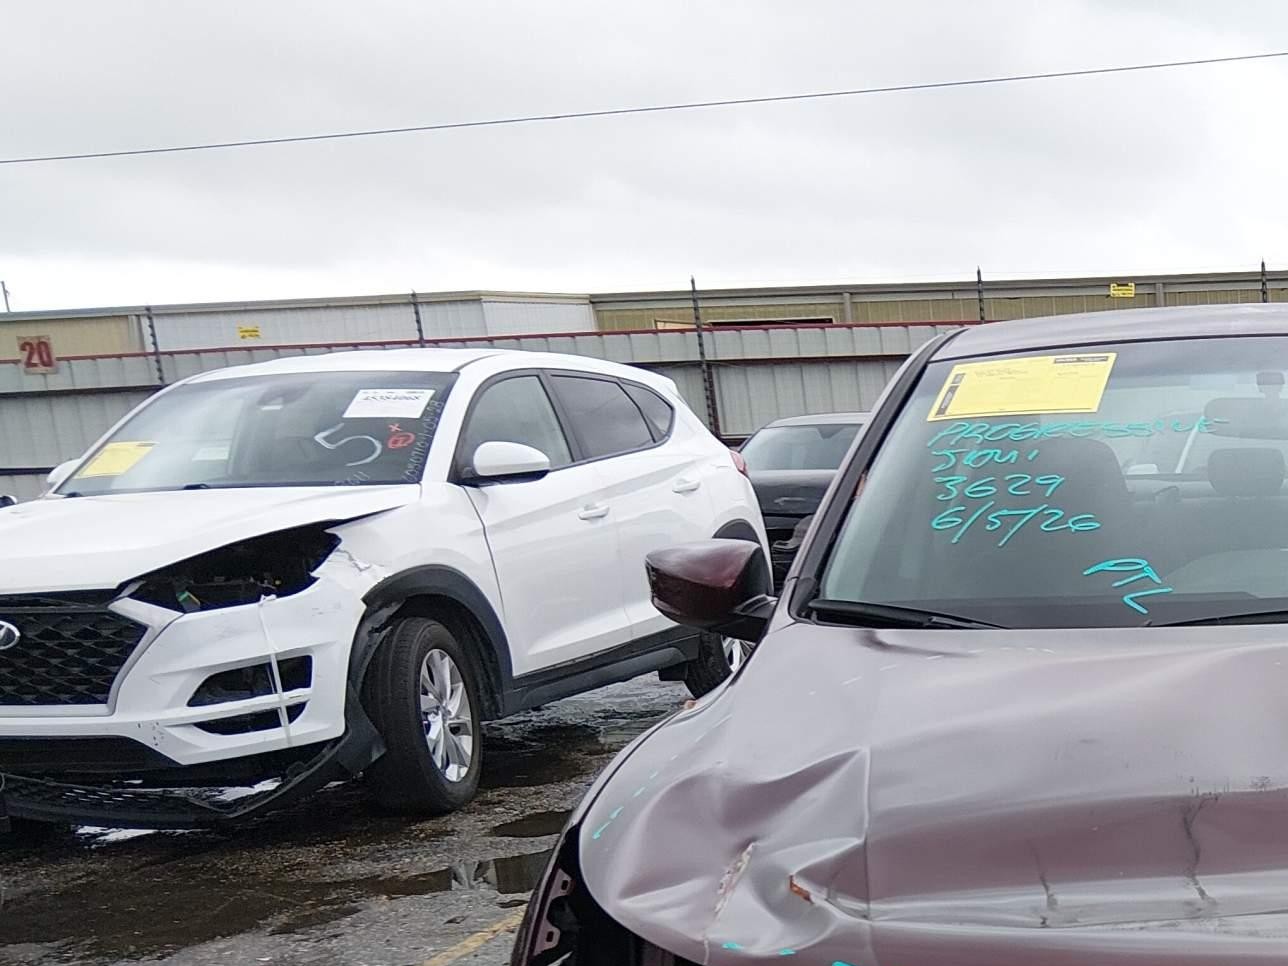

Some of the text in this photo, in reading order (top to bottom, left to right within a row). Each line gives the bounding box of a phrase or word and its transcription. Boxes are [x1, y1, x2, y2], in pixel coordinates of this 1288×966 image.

[20, 341, 53, 368] 20
[314, 423, 383, 466] 5
[933, 474, 1064, 500] 3629
[931, 501, 1101, 547] 6/5/26
